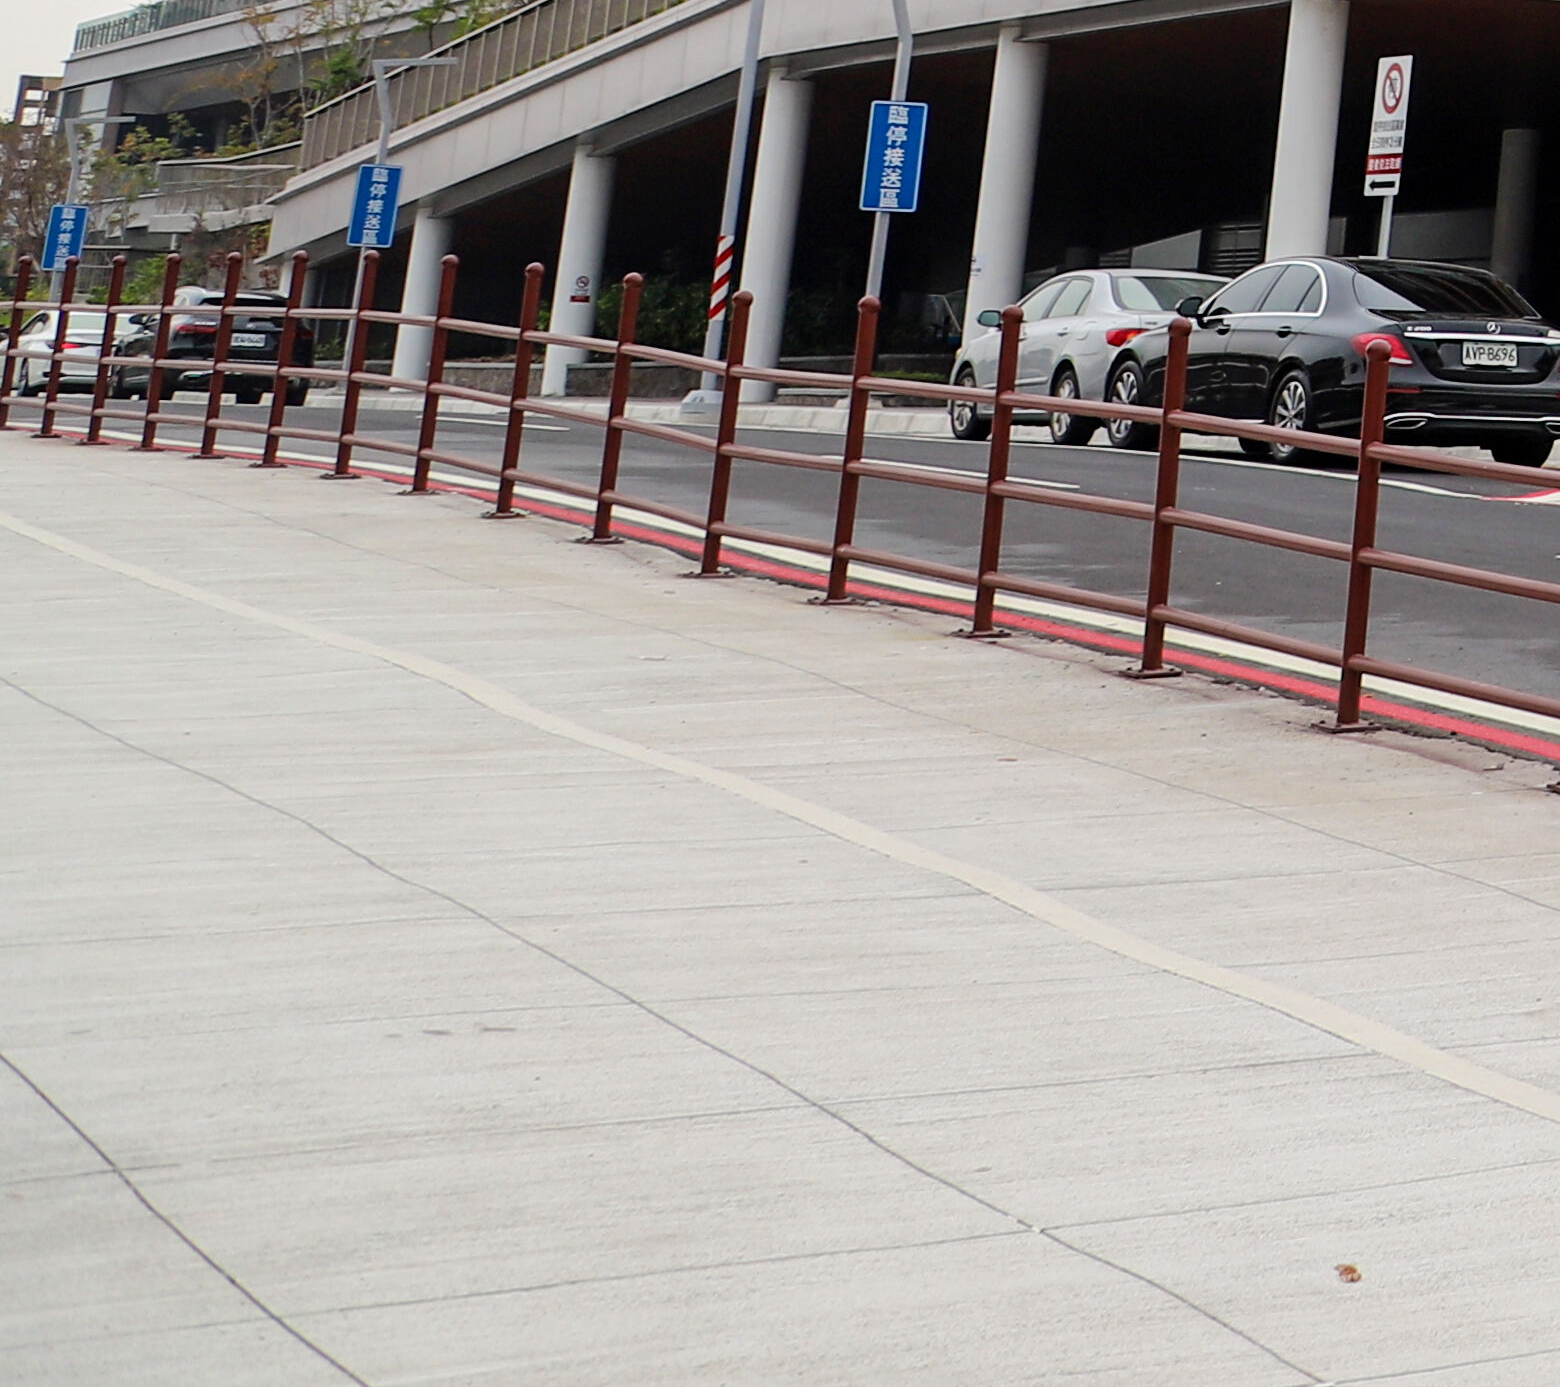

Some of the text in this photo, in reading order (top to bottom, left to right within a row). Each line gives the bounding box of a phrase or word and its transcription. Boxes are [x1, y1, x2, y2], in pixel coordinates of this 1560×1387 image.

[879, 105, 910, 208] 臨停接送區
